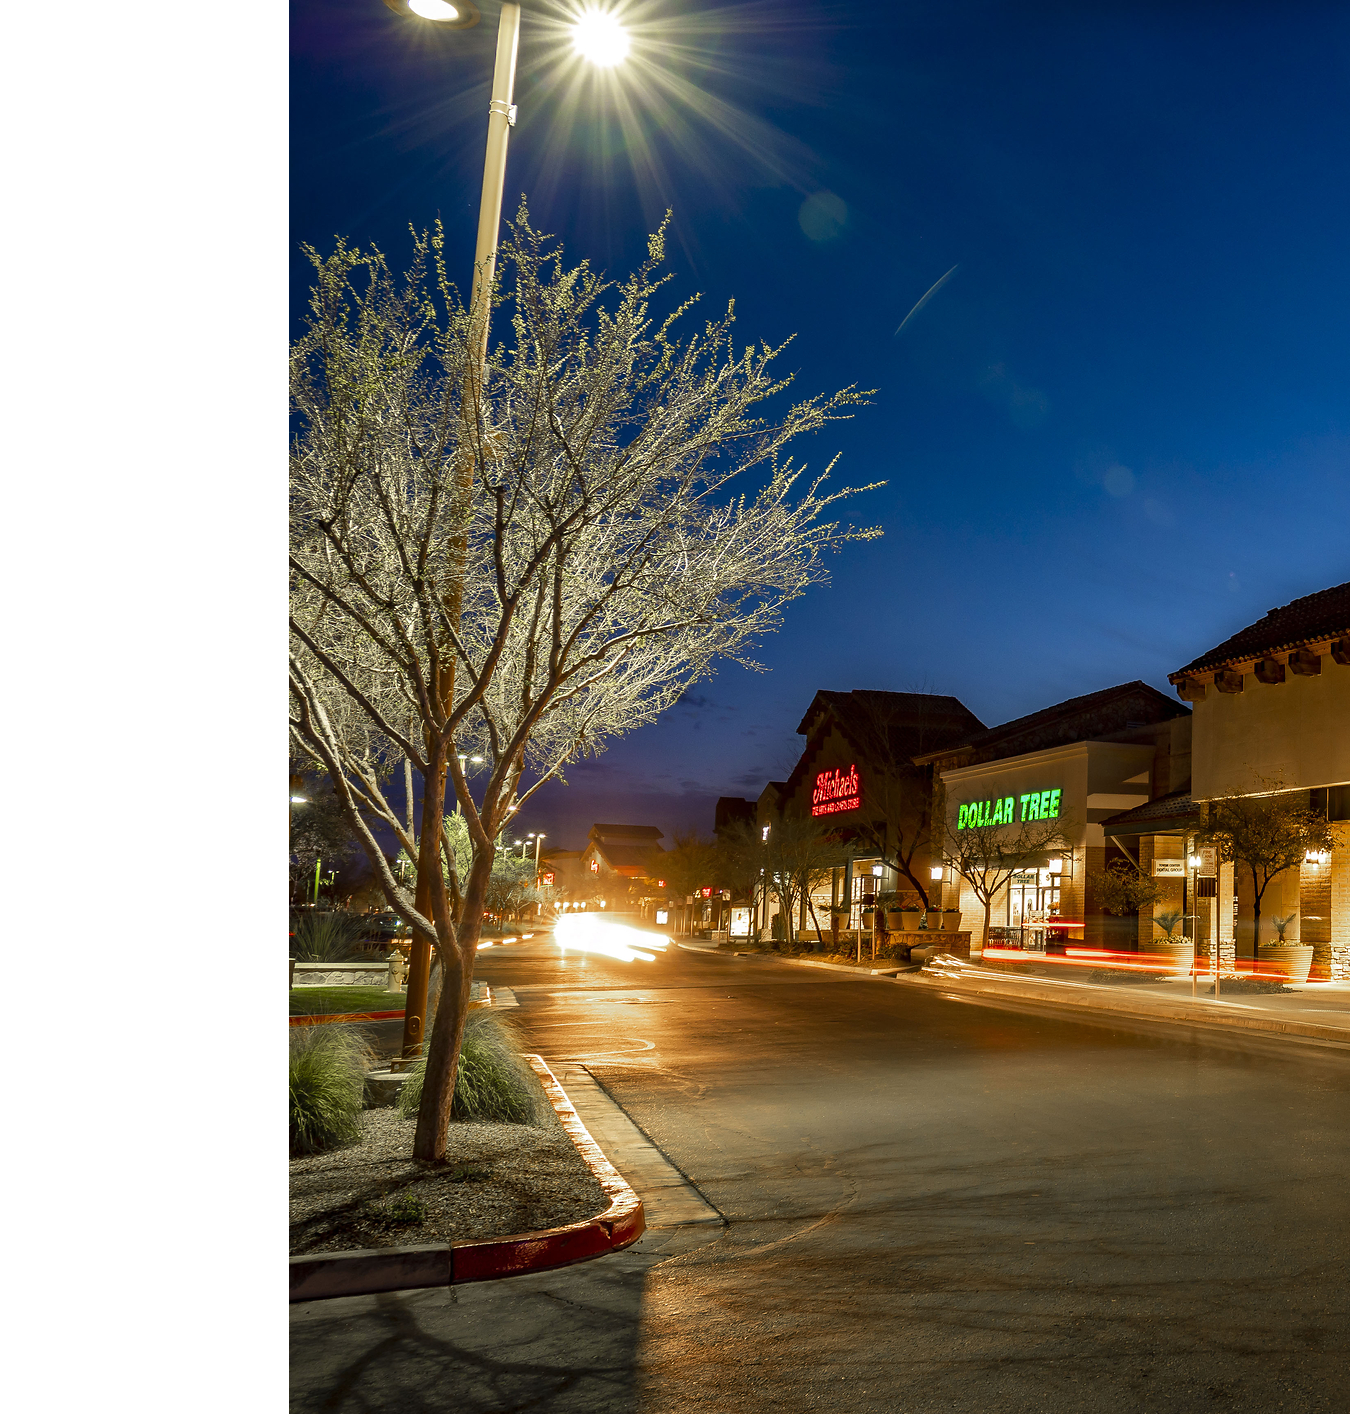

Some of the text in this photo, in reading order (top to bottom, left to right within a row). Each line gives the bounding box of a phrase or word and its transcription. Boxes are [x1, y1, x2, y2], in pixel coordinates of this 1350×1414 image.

[813, 764, 859, 804] Michaels
[958, 788, 1062, 830] DOLLAR TREE
